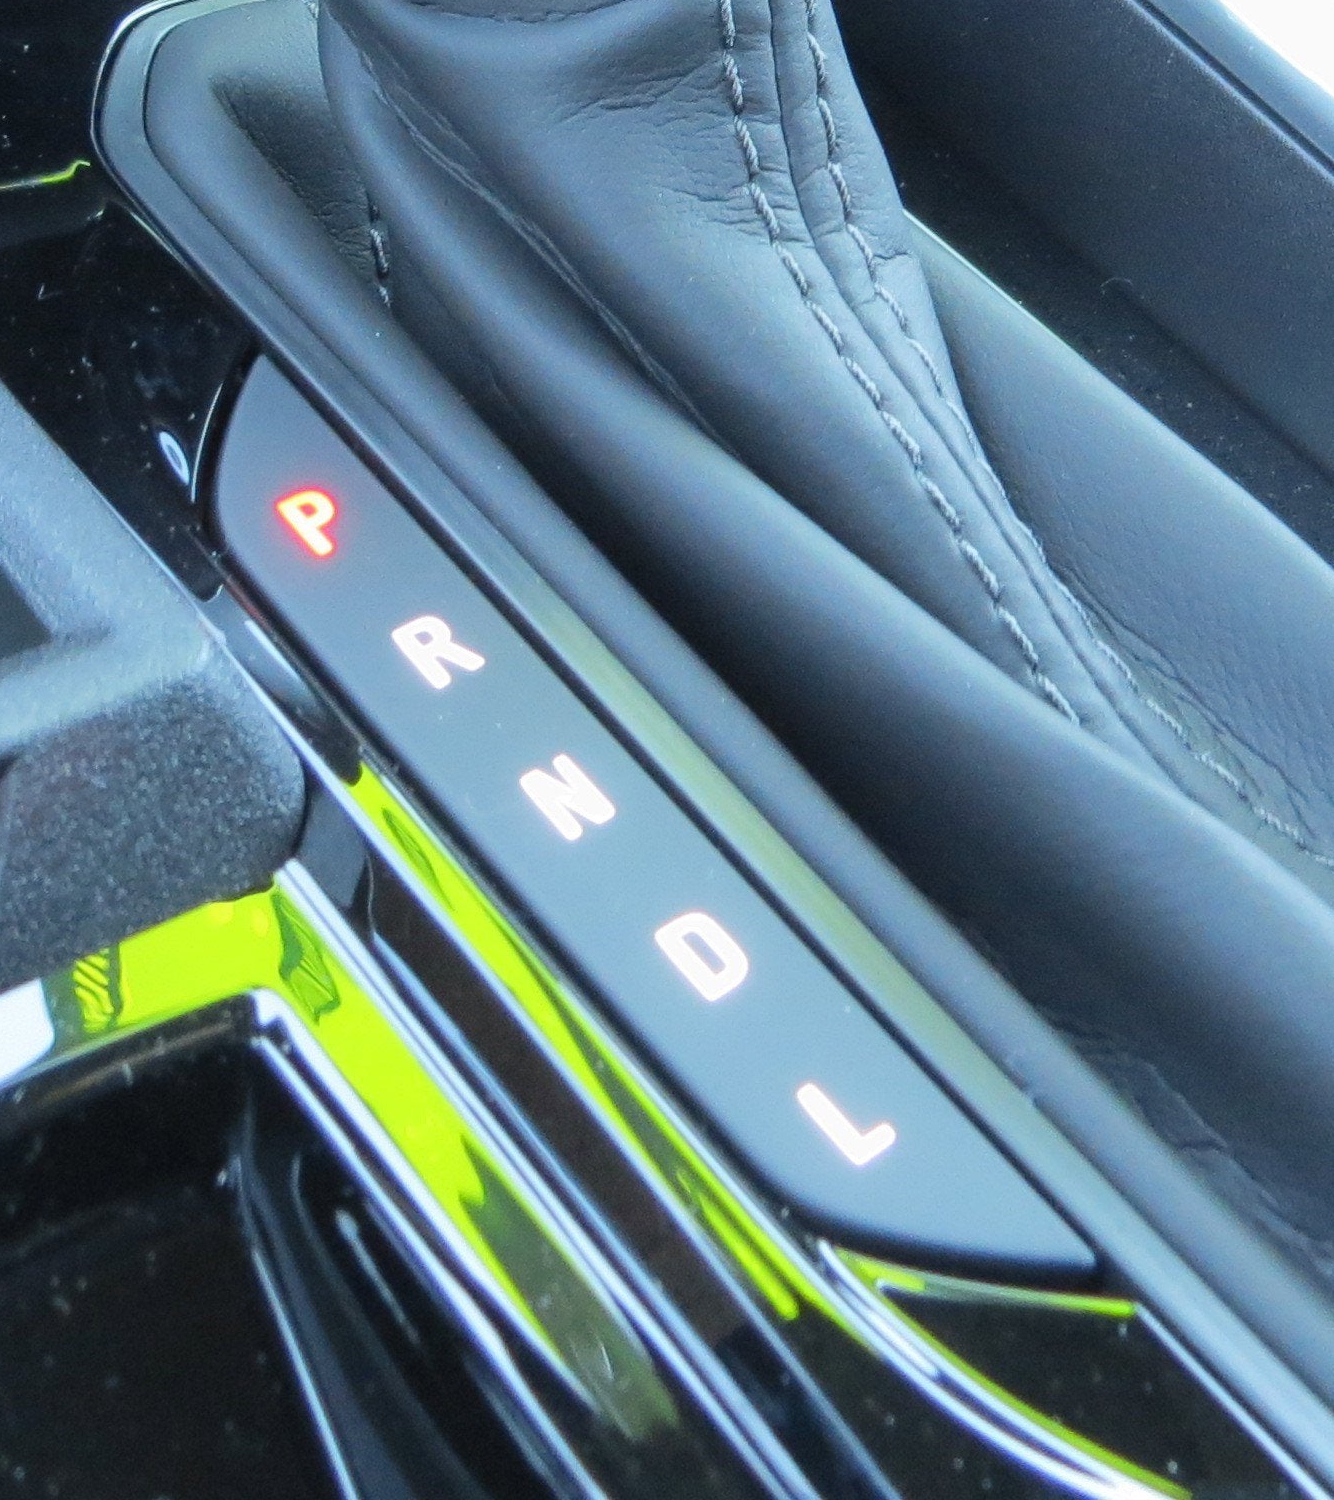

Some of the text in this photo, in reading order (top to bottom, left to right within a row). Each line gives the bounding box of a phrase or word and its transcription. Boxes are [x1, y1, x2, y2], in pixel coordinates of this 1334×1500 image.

[276, 489, 336, 558] P
[391, 615, 486, 690] R
[519, 753, 617, 842] N
[655, 911, 750, 1003] D
[796, 1082, 897, 1167] L
